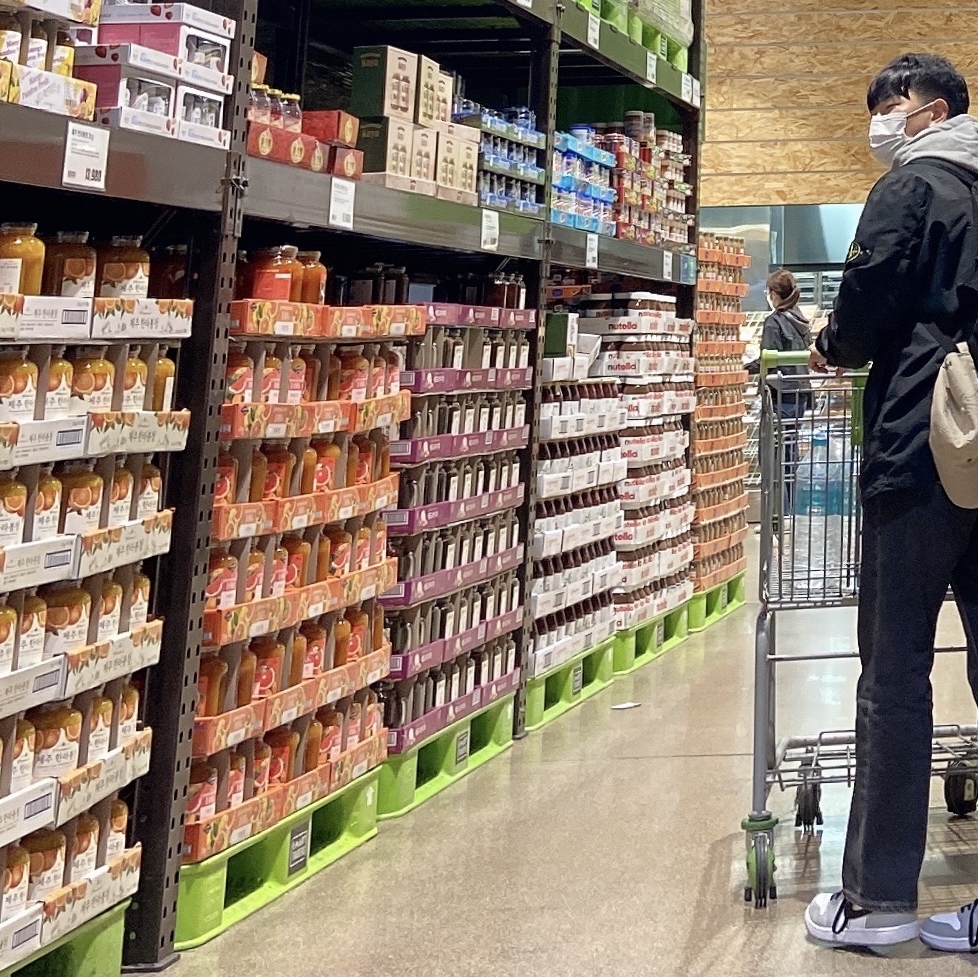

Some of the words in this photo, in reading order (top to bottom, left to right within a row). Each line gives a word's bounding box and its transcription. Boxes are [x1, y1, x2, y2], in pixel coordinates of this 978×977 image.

[608, 322, 638, 330] nutella
[607, 363, 637, 371] nutella
[614, 532, 633, 541] tella
